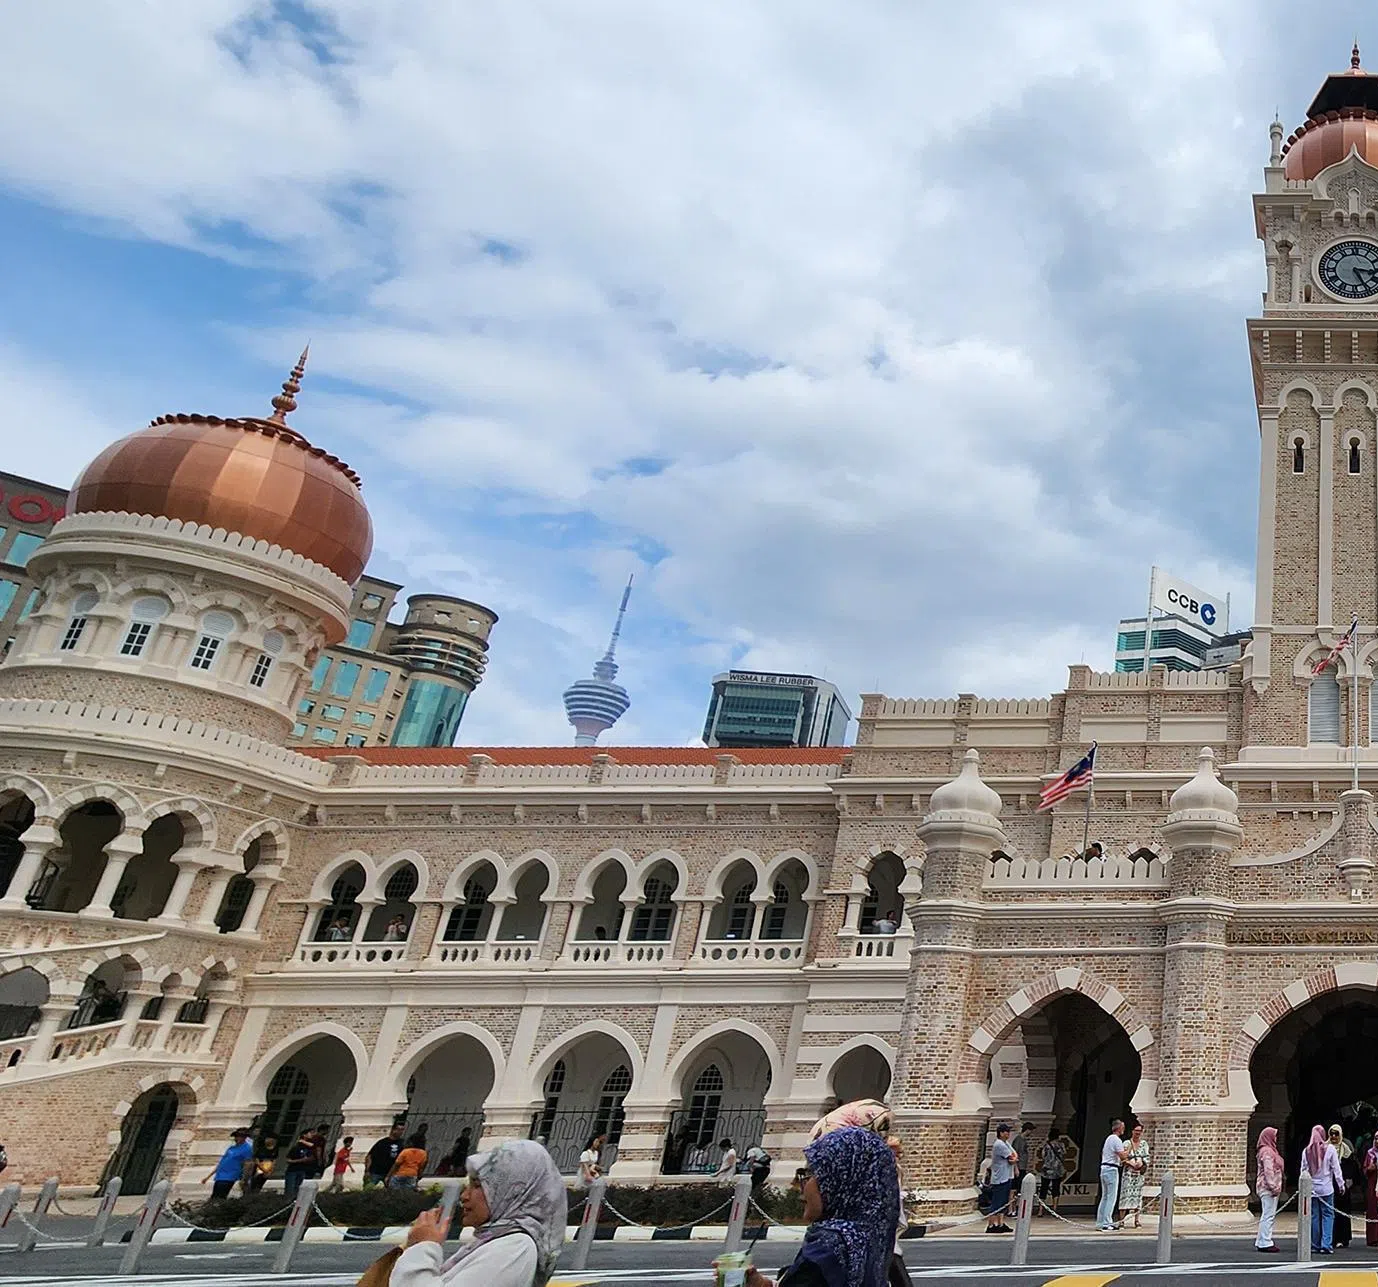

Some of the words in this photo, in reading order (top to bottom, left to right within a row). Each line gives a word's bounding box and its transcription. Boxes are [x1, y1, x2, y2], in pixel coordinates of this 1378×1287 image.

[1167, 588, 1199, 614] CCB
[729, 673, 758, 682] WISMA
[760, 675, 777, 684] LEE
[779, 676, 814, 686] RUBBER
[1073, 1184, 1090, 1195] KL
